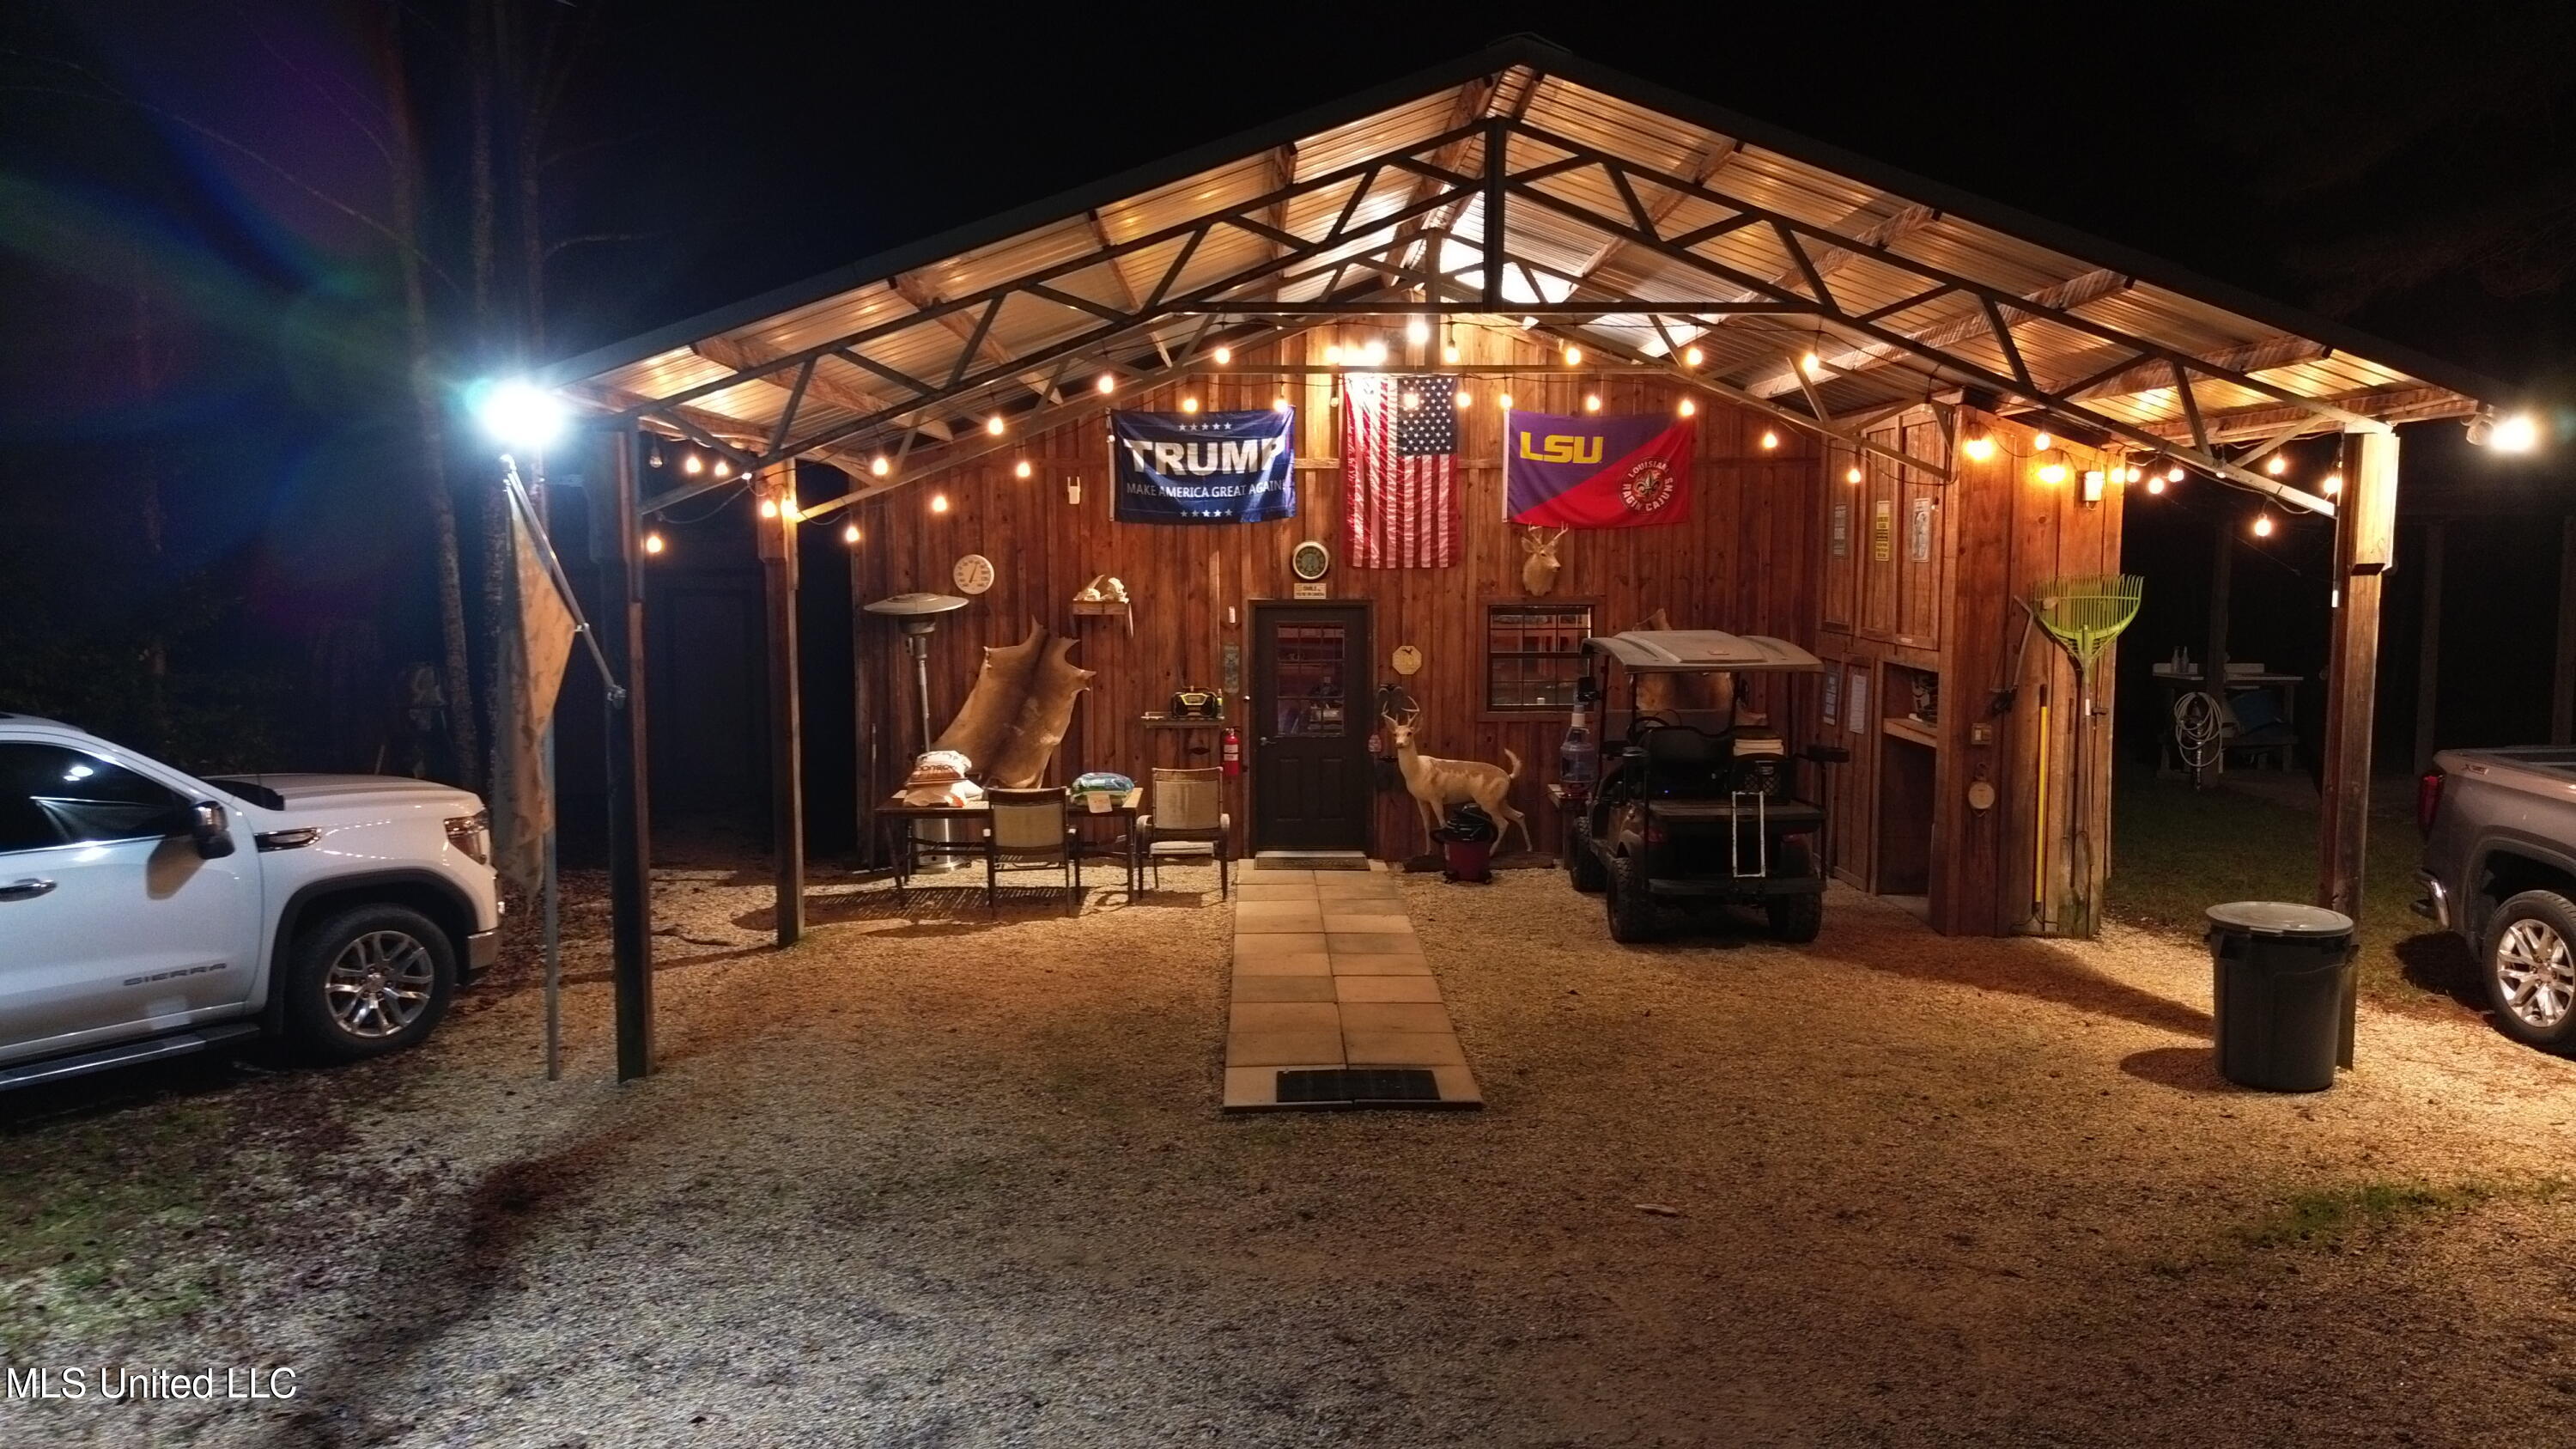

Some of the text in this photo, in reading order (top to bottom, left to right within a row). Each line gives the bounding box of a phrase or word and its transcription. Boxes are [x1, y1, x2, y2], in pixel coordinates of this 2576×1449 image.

[1123, 435, 1285, 476] TRUMP
[1520, 431, 1604, 464] LSU
[1127, 483, 1157, 496] MAKE
[1158, 485, 1209, 498] AMERICA
[1212, 485, 1245, 497] GREAT
[1645, 477, 1674, 512] CAJUNS
[124, 963, 227, 986] SIERRA
